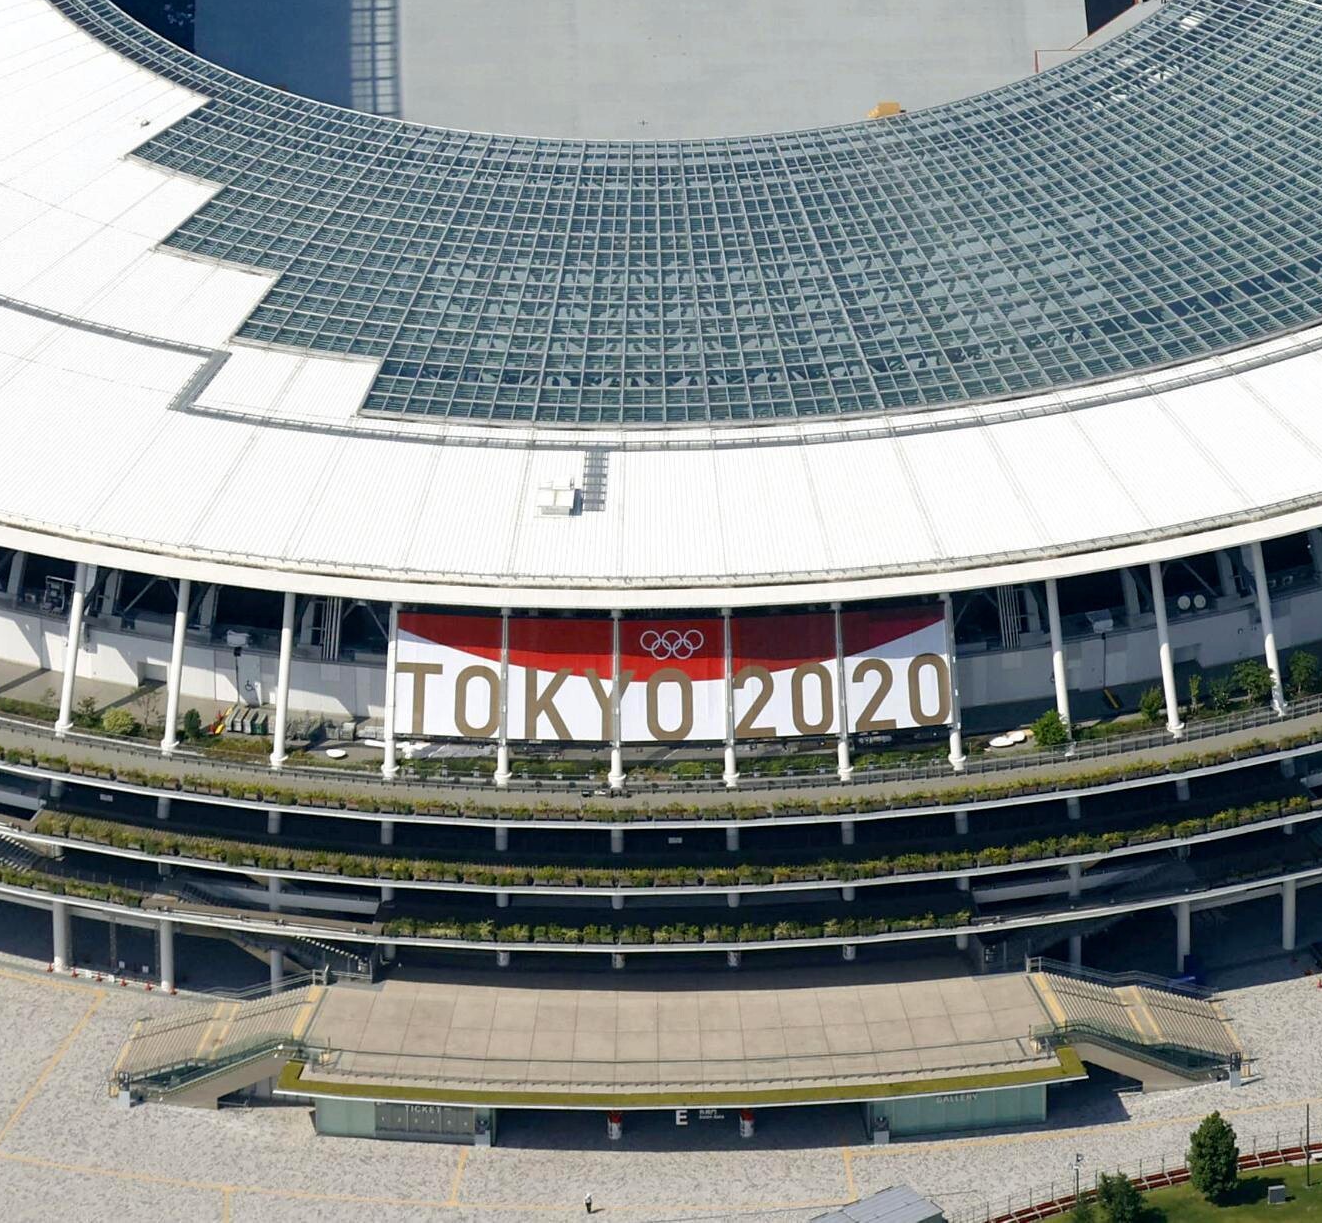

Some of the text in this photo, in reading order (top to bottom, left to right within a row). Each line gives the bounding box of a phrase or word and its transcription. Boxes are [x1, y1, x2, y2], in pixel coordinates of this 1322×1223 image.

[396, 653, 952, 742] TOKYO 2020
[405, 1104, 441, 1114] TICKET
[675, 1109, 688, 1125] E
